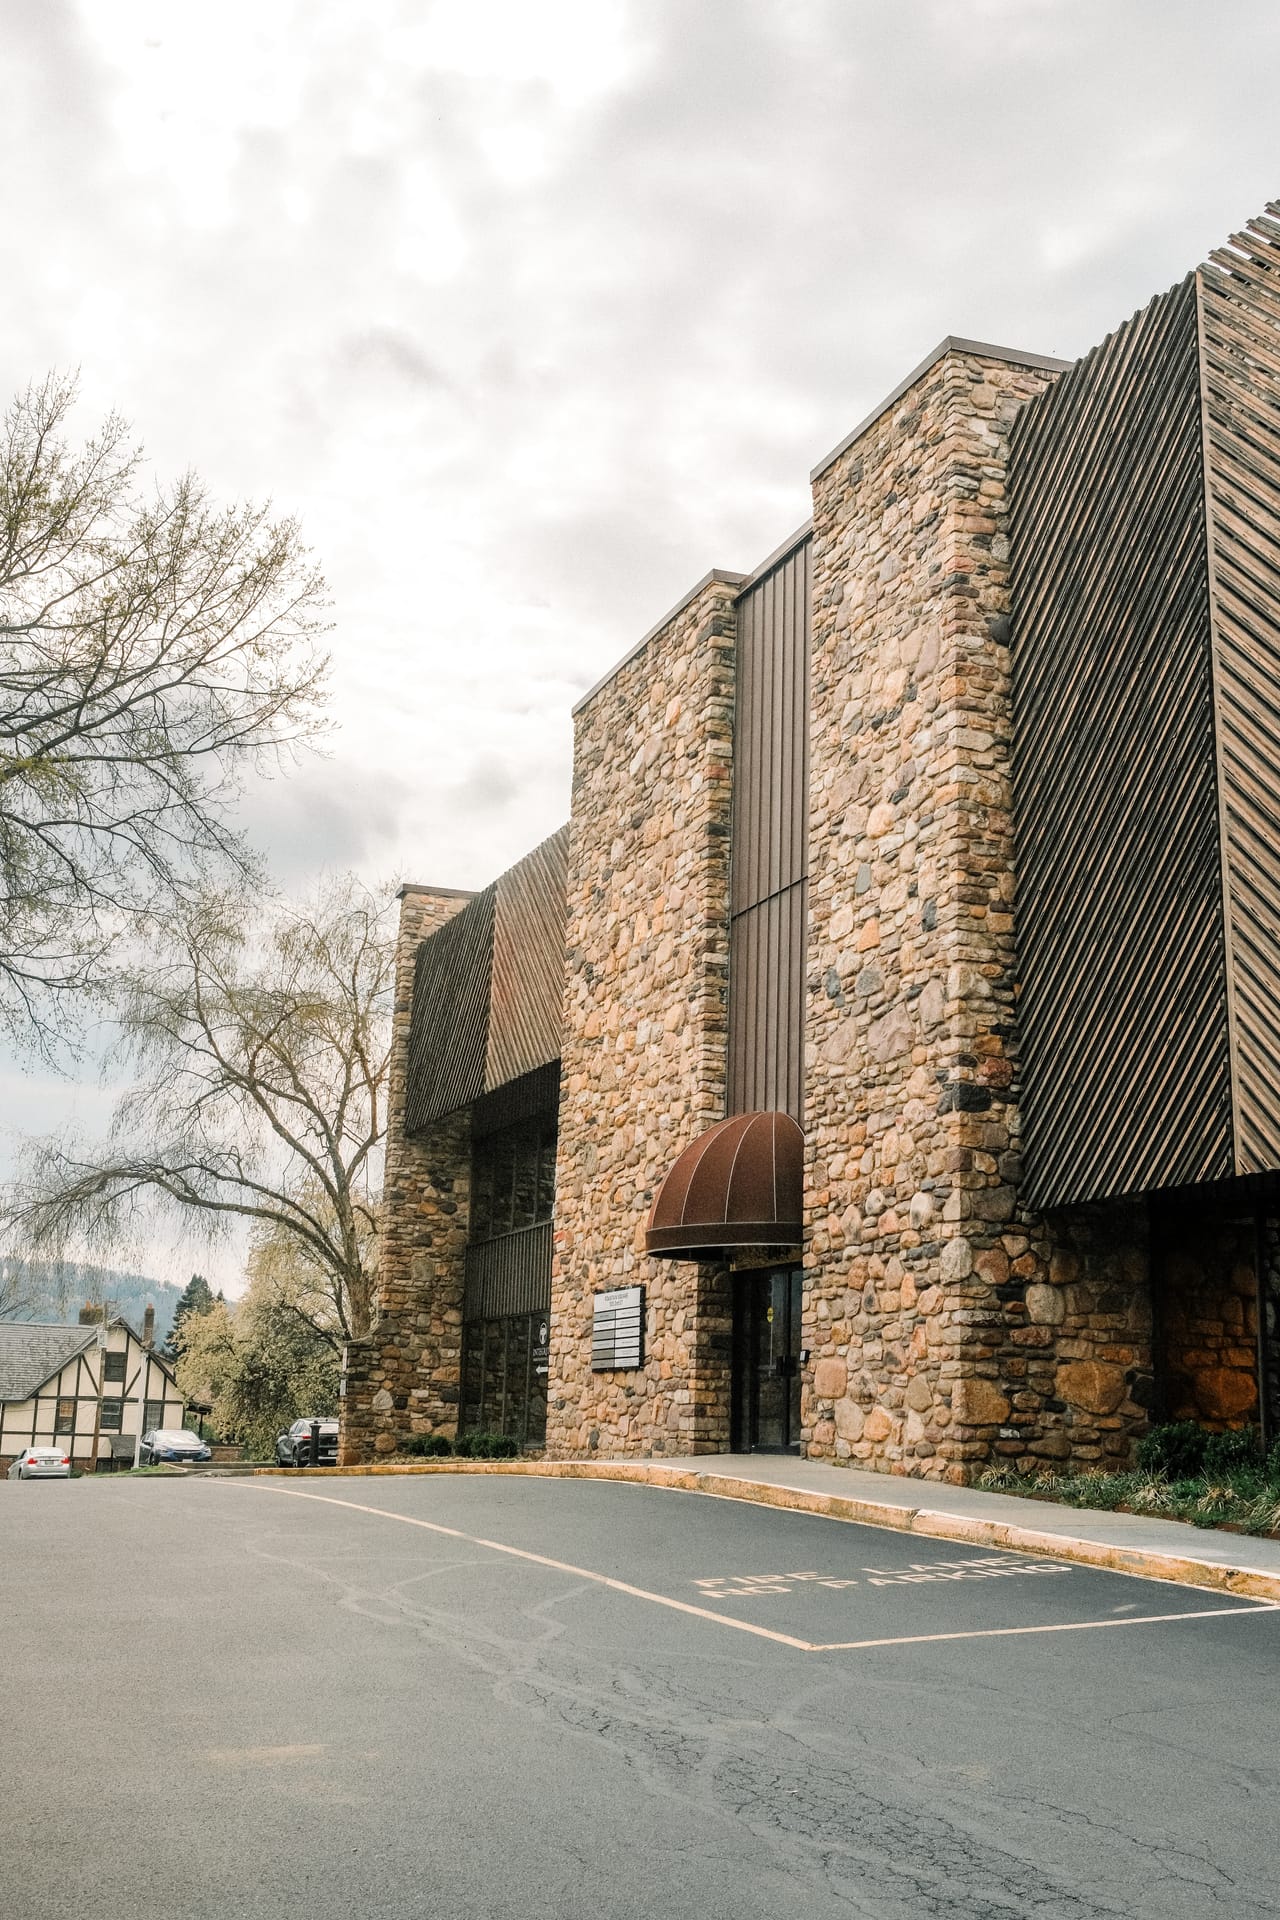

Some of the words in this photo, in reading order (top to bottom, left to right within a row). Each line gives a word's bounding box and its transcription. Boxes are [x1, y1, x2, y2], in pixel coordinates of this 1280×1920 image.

[692, 1571, 834, 1588] FIRE
[862, 1556, 1032, 1575] LANE
[700, 1585, 792, 1598] NO
[818, 1564, 1072, 1589] PARKING
